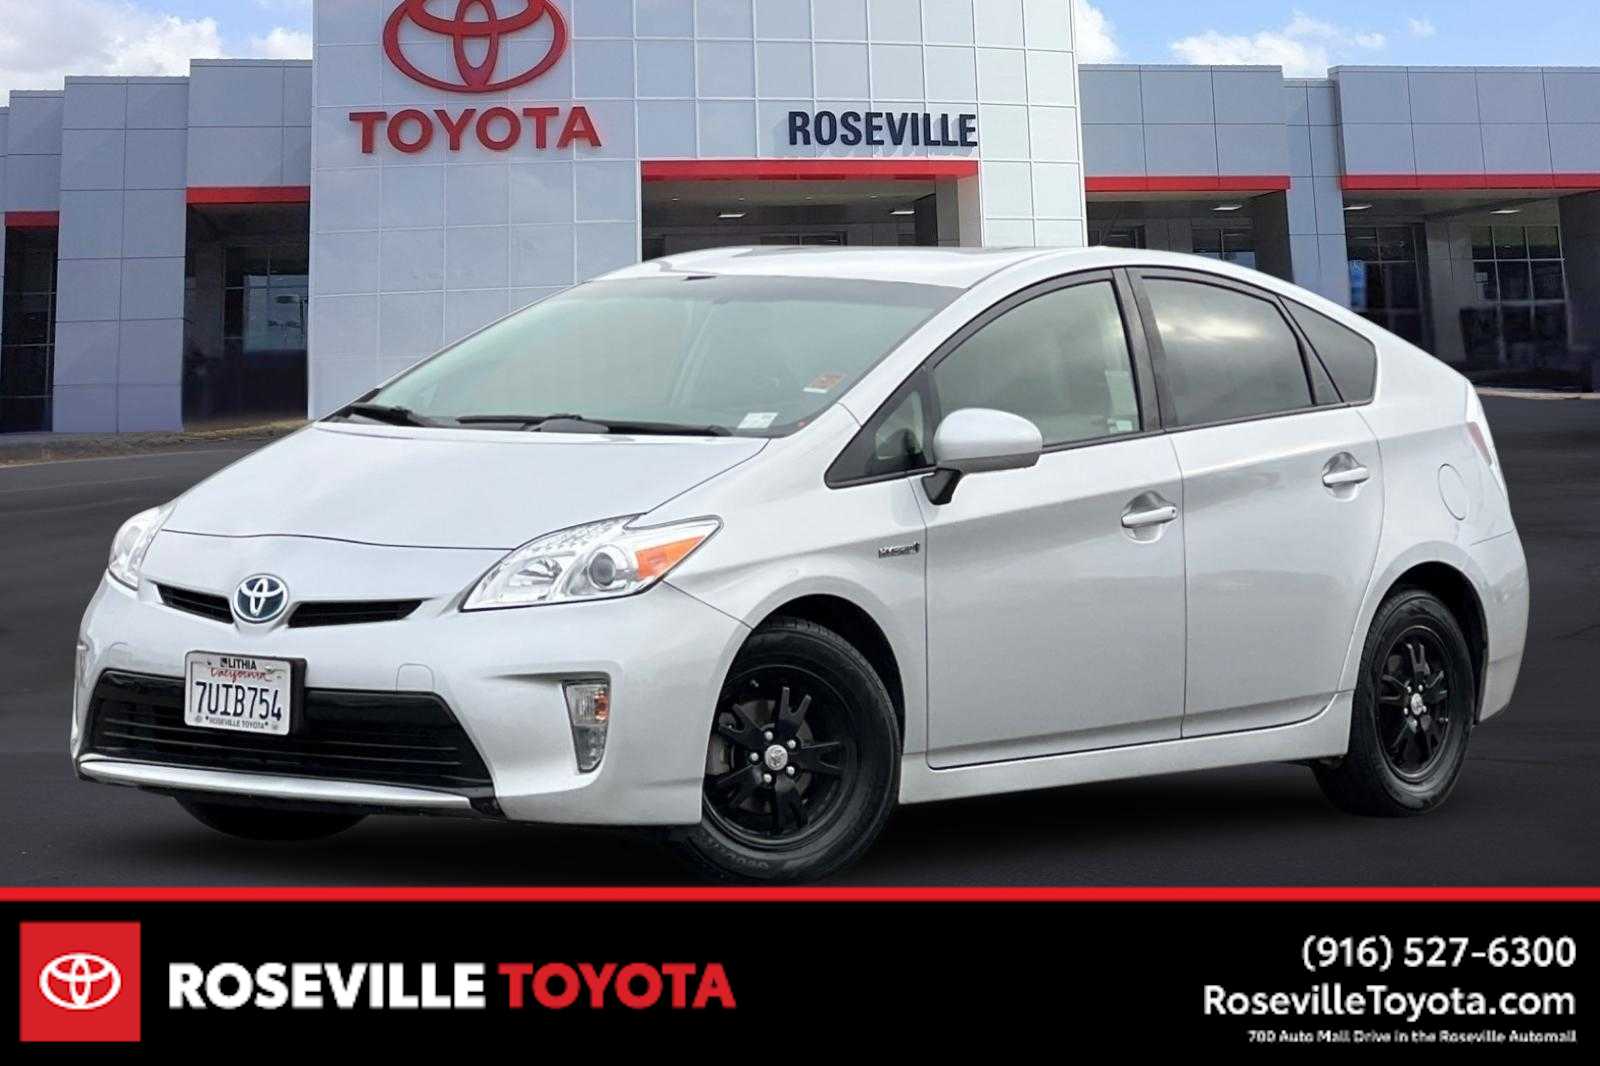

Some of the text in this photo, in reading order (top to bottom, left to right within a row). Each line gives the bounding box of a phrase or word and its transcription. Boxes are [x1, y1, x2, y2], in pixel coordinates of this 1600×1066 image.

[349, 106, 602, 154] TOYOTA
[788, 111, 978, 147] ROSEVILLE
[228, 658, 257, 670] LITHIA
[195, 680, 282, 721] 7UIB754
